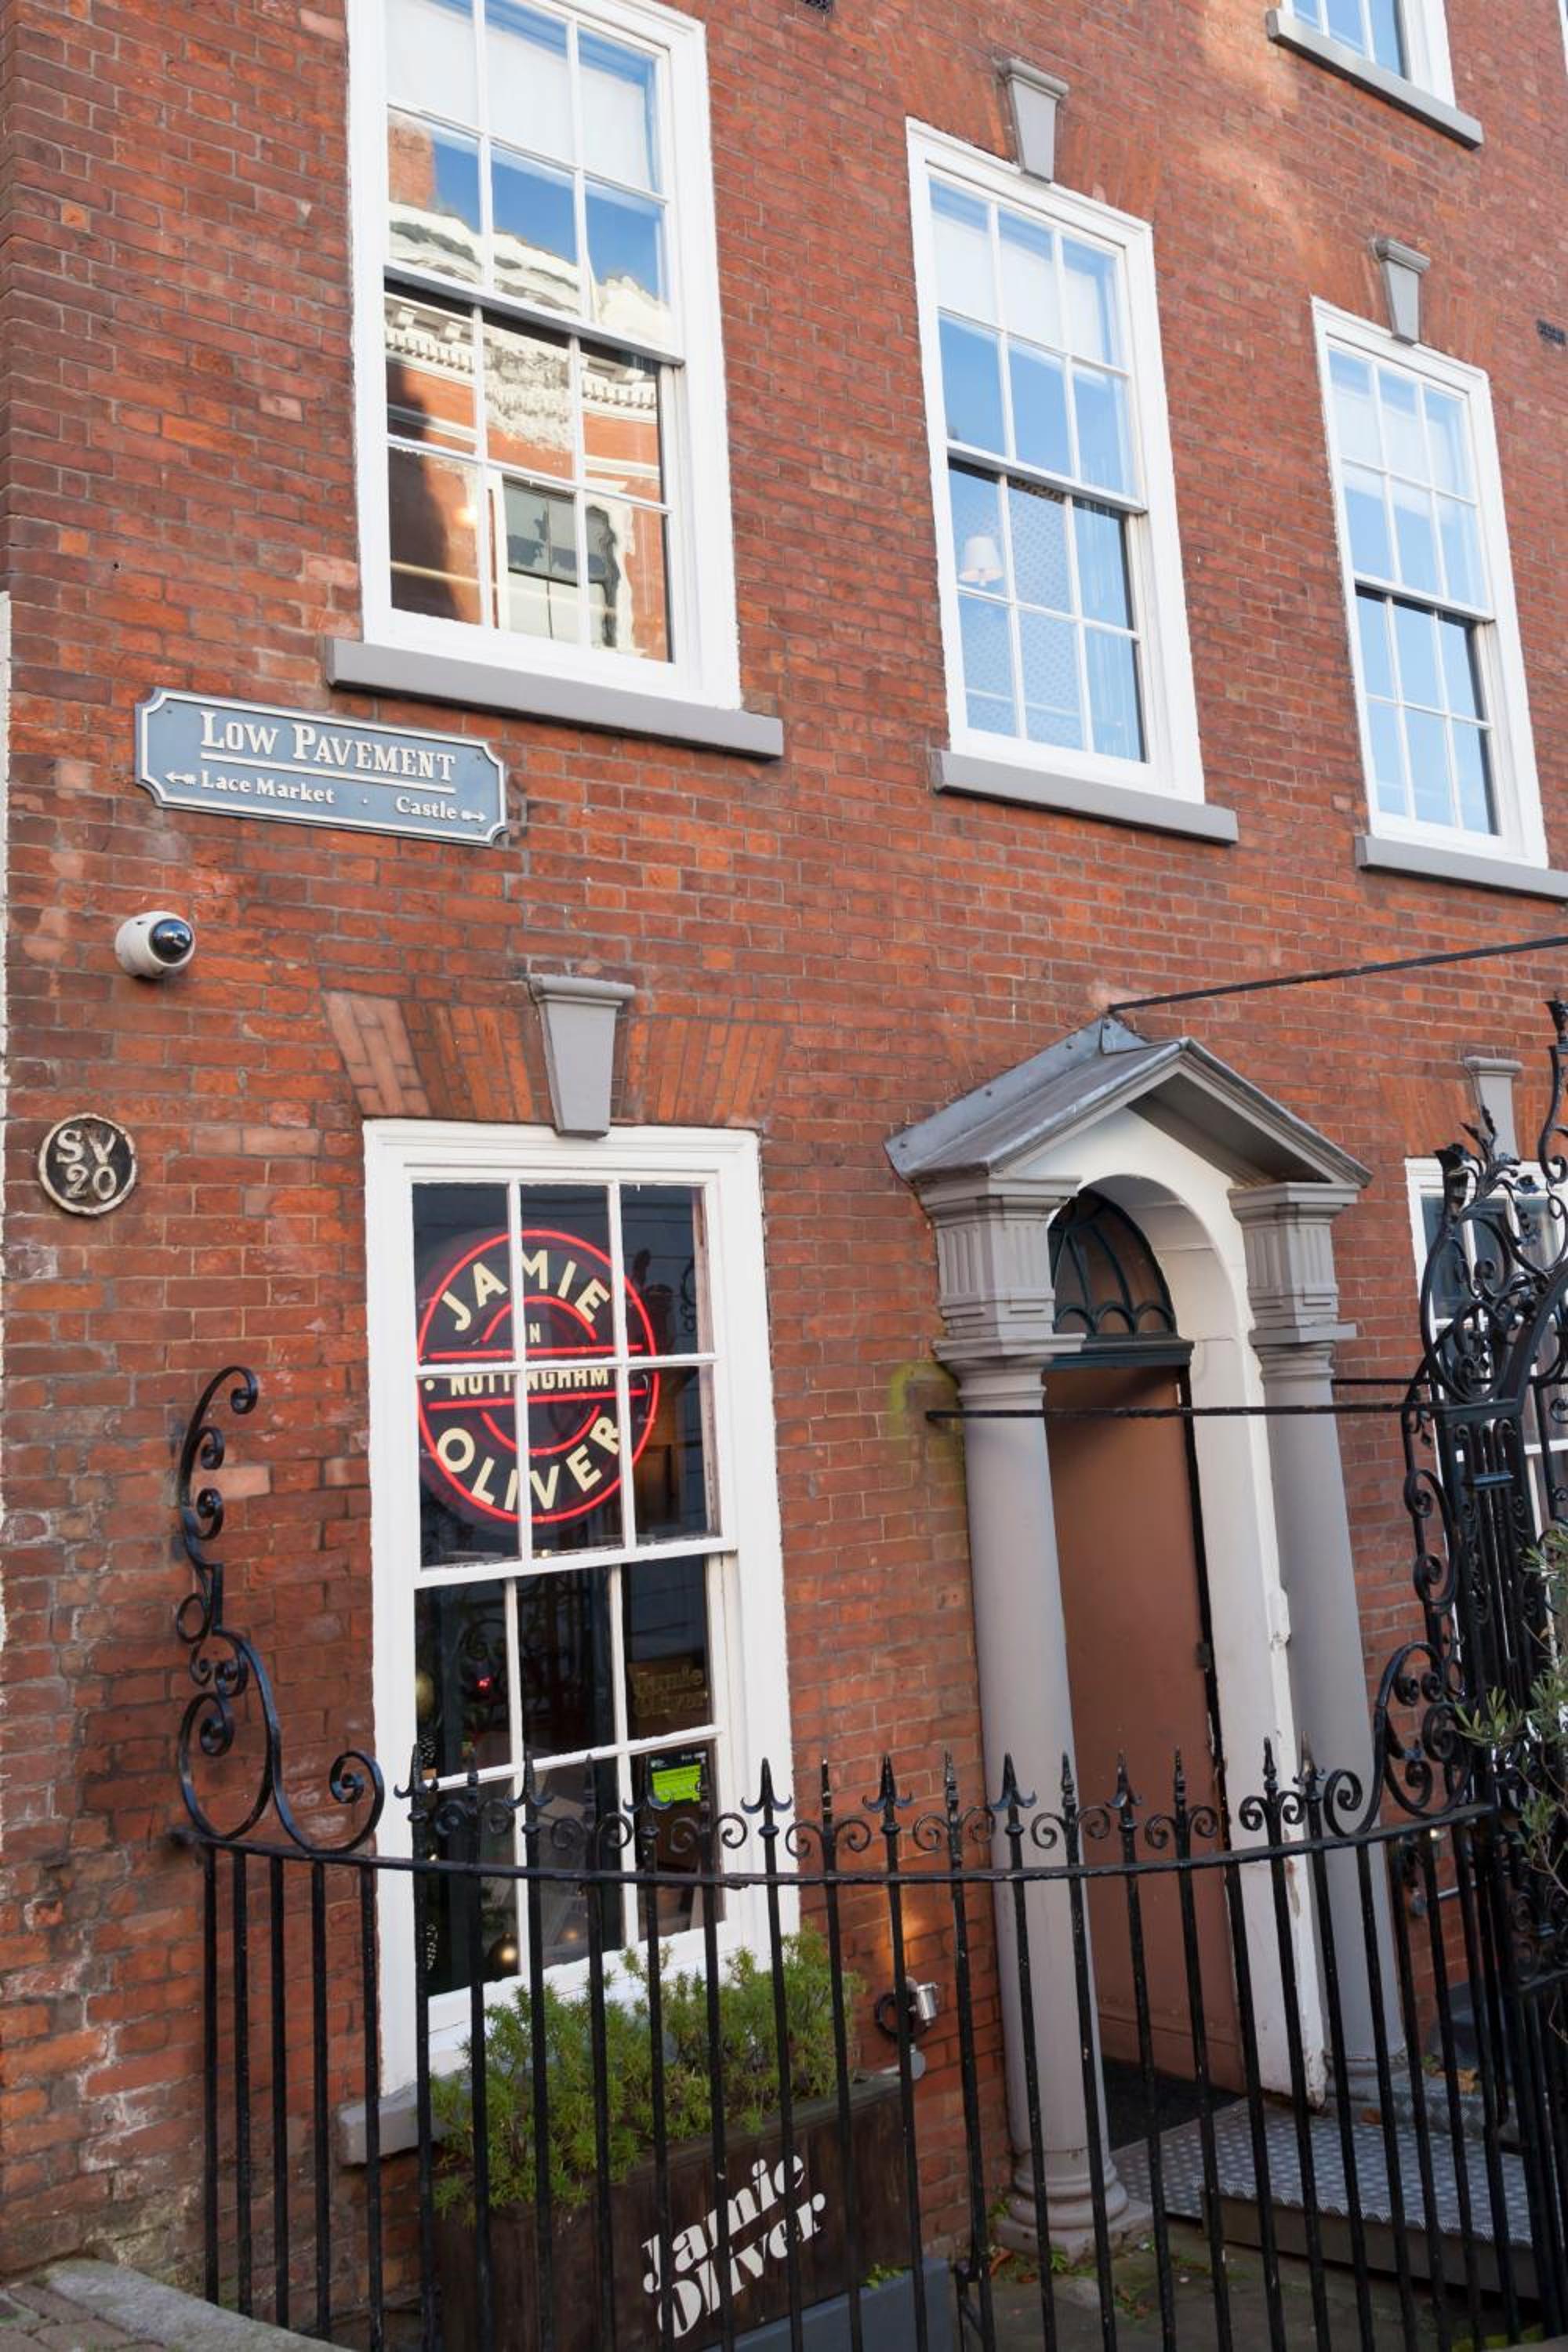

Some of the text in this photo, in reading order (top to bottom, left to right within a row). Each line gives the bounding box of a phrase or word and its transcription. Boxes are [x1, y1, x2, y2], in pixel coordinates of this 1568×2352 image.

[200, 710, 456, 782] LOW PAVEMENT
[201, 770, 458, 820] Lace Market Castle
[55, 1129, 117, 1164] SY
[65, 1163, 117, 1200] 20
[441, 1249, 612, 1332] JAMIE
[450, 1367, 609, 1397] NOTTNGHAM
[437, 1416, 621, 1511] OLIVER
